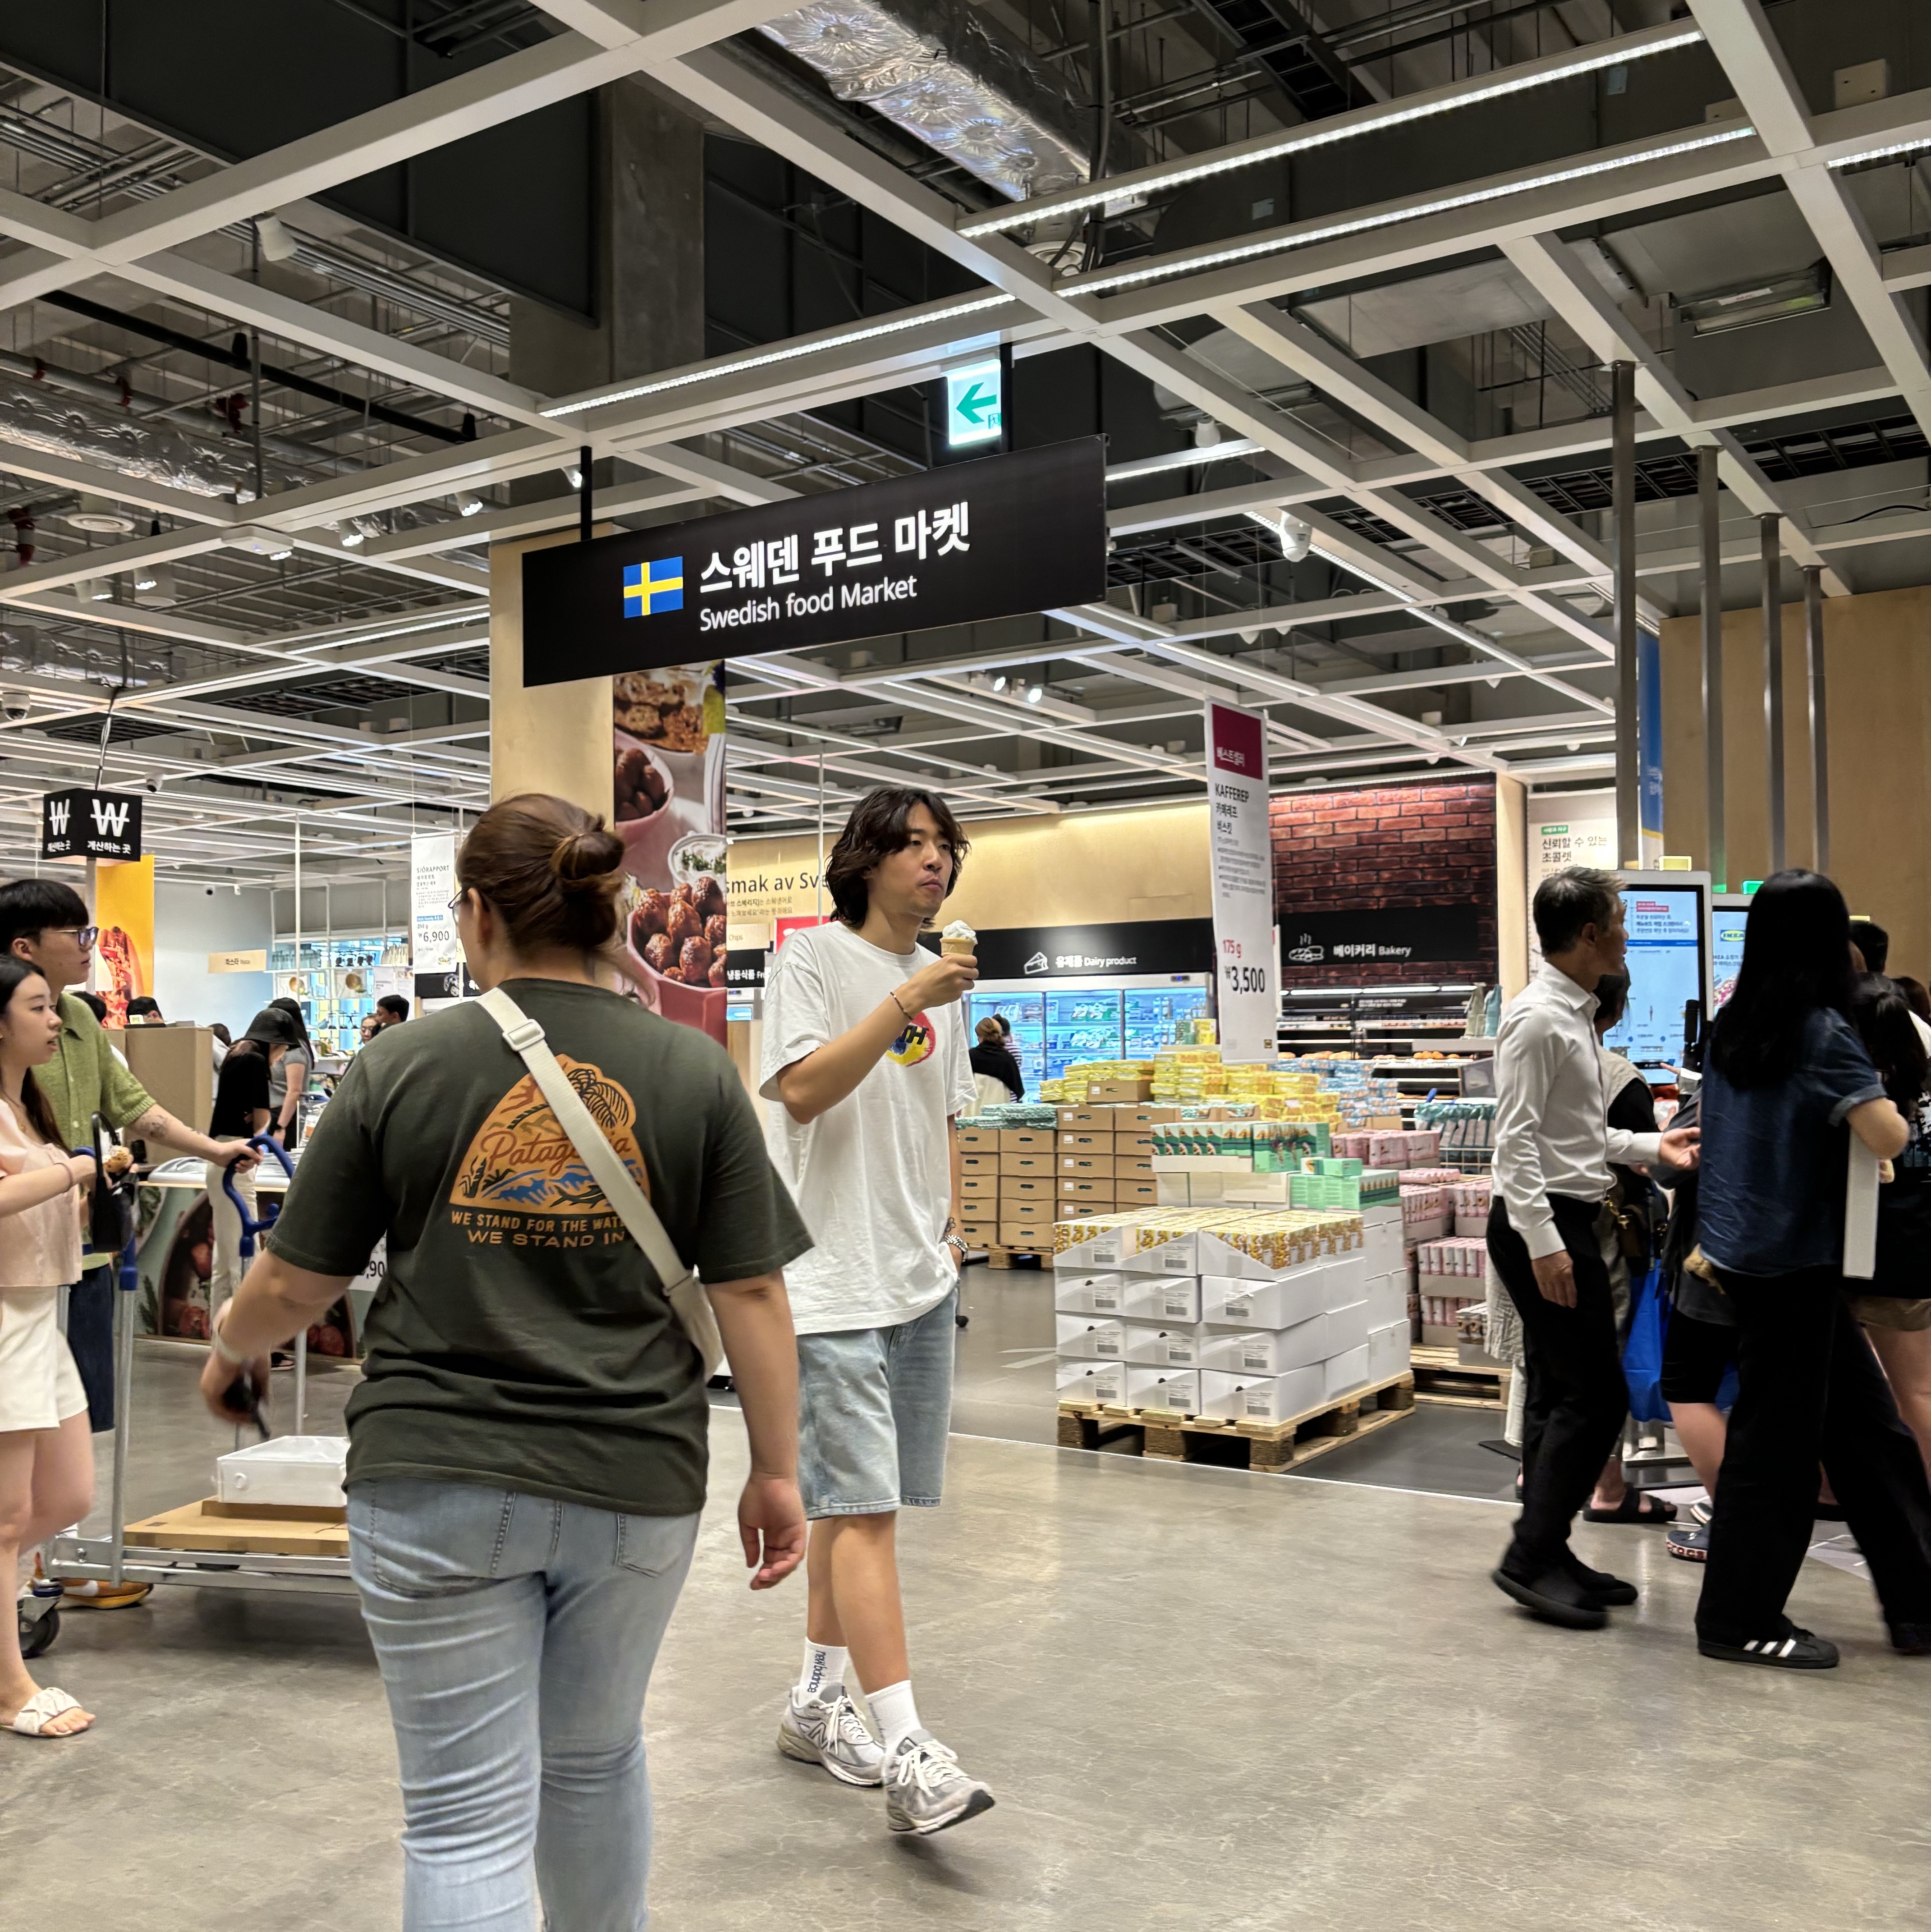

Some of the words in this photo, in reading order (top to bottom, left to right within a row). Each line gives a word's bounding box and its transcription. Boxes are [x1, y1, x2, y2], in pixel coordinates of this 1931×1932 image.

[700, 534, 799, 592] 스웨덴
[812, 523, 882, 577] 푸드
[895, 501, 970, 560] 마켓
[700, 596, 780, 631] Swedish
[785, 586, 834, 618] food
[841, 575, 917, 609] Market
[87, 840, 121, 853] 계산하는
[1542, 837, 1571, 849] 신뢰할
[1574, 837, 1584, 848] 수
[1587, 835, 1607, 846] 있는
[774, 877, 794, 890] av
[1333, 944, 1376, 957] 베이커리
[1378, 945, 1412, 958] Bakery
[1084, 957, 1105, 968] Dairy
[1105, 956, 1137, 968] product
[451, 1211, 472, 1226] WE
[477, 1214, 521, 1230] STAND
[526, 1219, 555, 1233] FOR
[560, 1219, 588, 1233] THE
[592, 1216, 625, 1230] WAT
[467, 1230, 504, 1244] WE
[512, 1233, 595, 1248] STAND
[604, 1230, 626, 1245] IN
